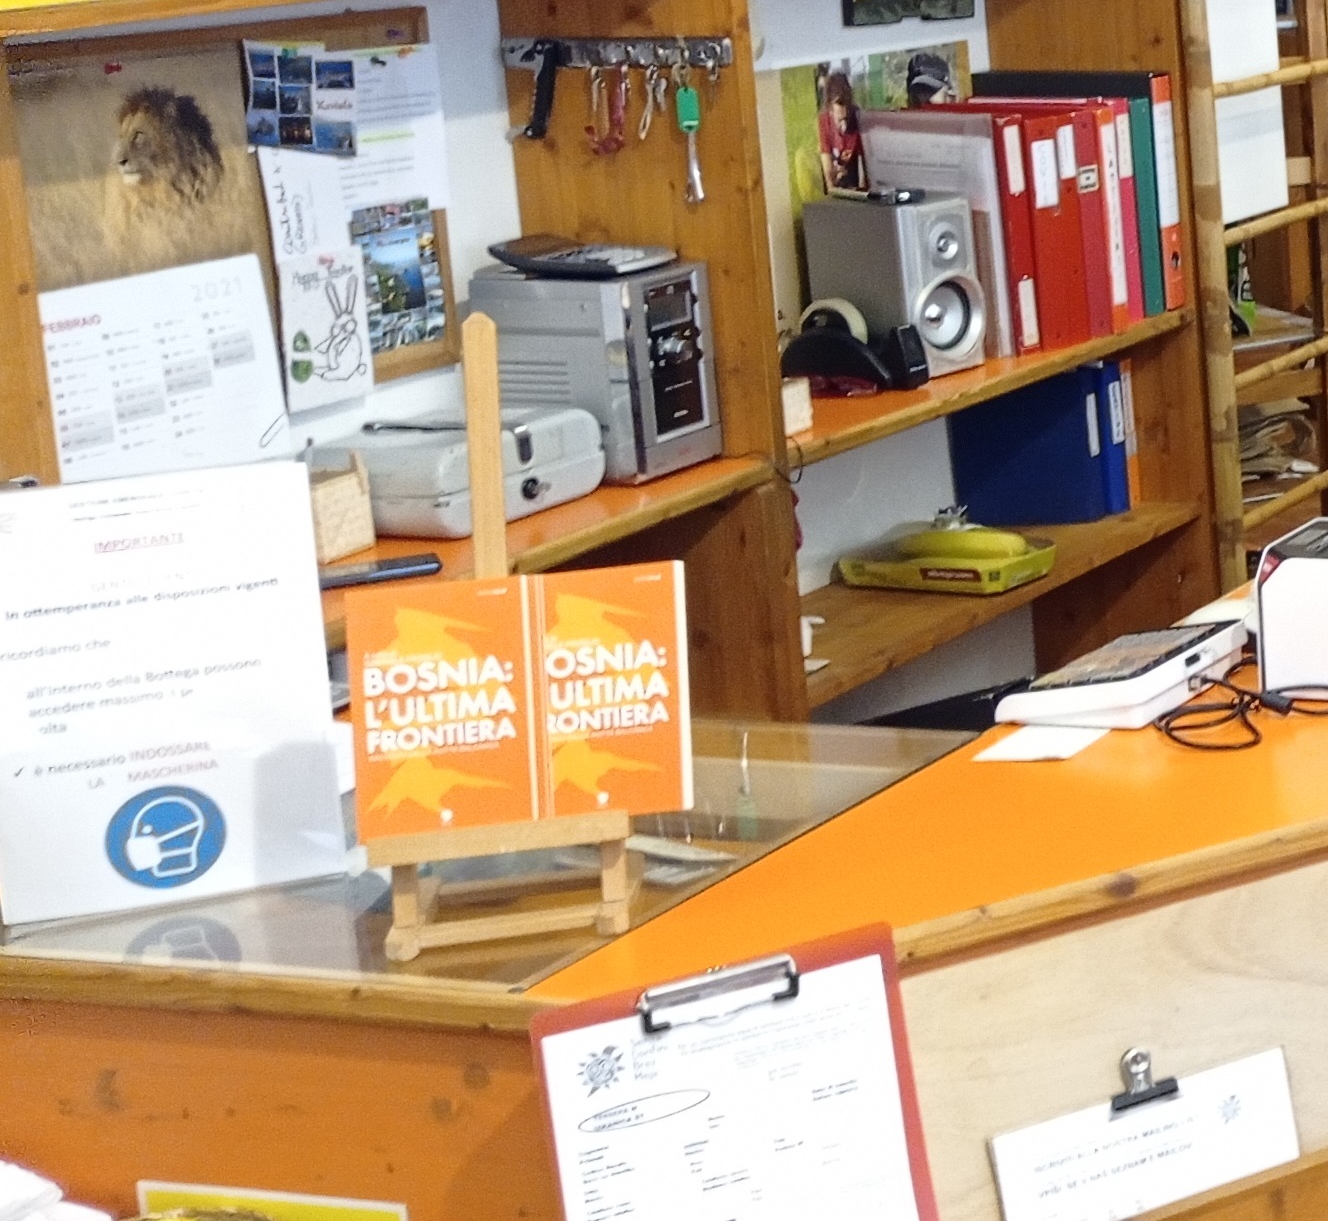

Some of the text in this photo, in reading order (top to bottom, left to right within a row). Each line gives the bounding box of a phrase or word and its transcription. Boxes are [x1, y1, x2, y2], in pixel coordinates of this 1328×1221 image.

[190, 275, 243, 302] 2021
[41, 314, 102, 334] FEBBRAIO
[95, 533, 184, 553] IMPORTANTE
[24, 599, 122, 619] ottemperanza
[126, 594, 148, 606] alle
[154, 584, 230, 602] disposizioni
[0, 638, 111, 662] ricordiamo che
[545, 640, 667, 679] OSNIA:
[106, 674, 141, 688] della
[204, 658, 262, 675] possono
[363, 655, 514, 697] BOSNIA:
[28, 697, 96, 718] accedere
[99, 689, 163, 708] massimo
[550, 671, 669, 710] ULTIMA
[364, 686, 518, 730] L'ULTIMA
[547, 701, 670, 735] RONTIERA
[39, 722, 68, 735] olta
[366, 717, 518, 754] FRONTIERA
[48, 754, 126, 774] necessario
[129, 741, 212, 762] INDOSSARE
[128, 759, 219, 782] MASCHERINA
